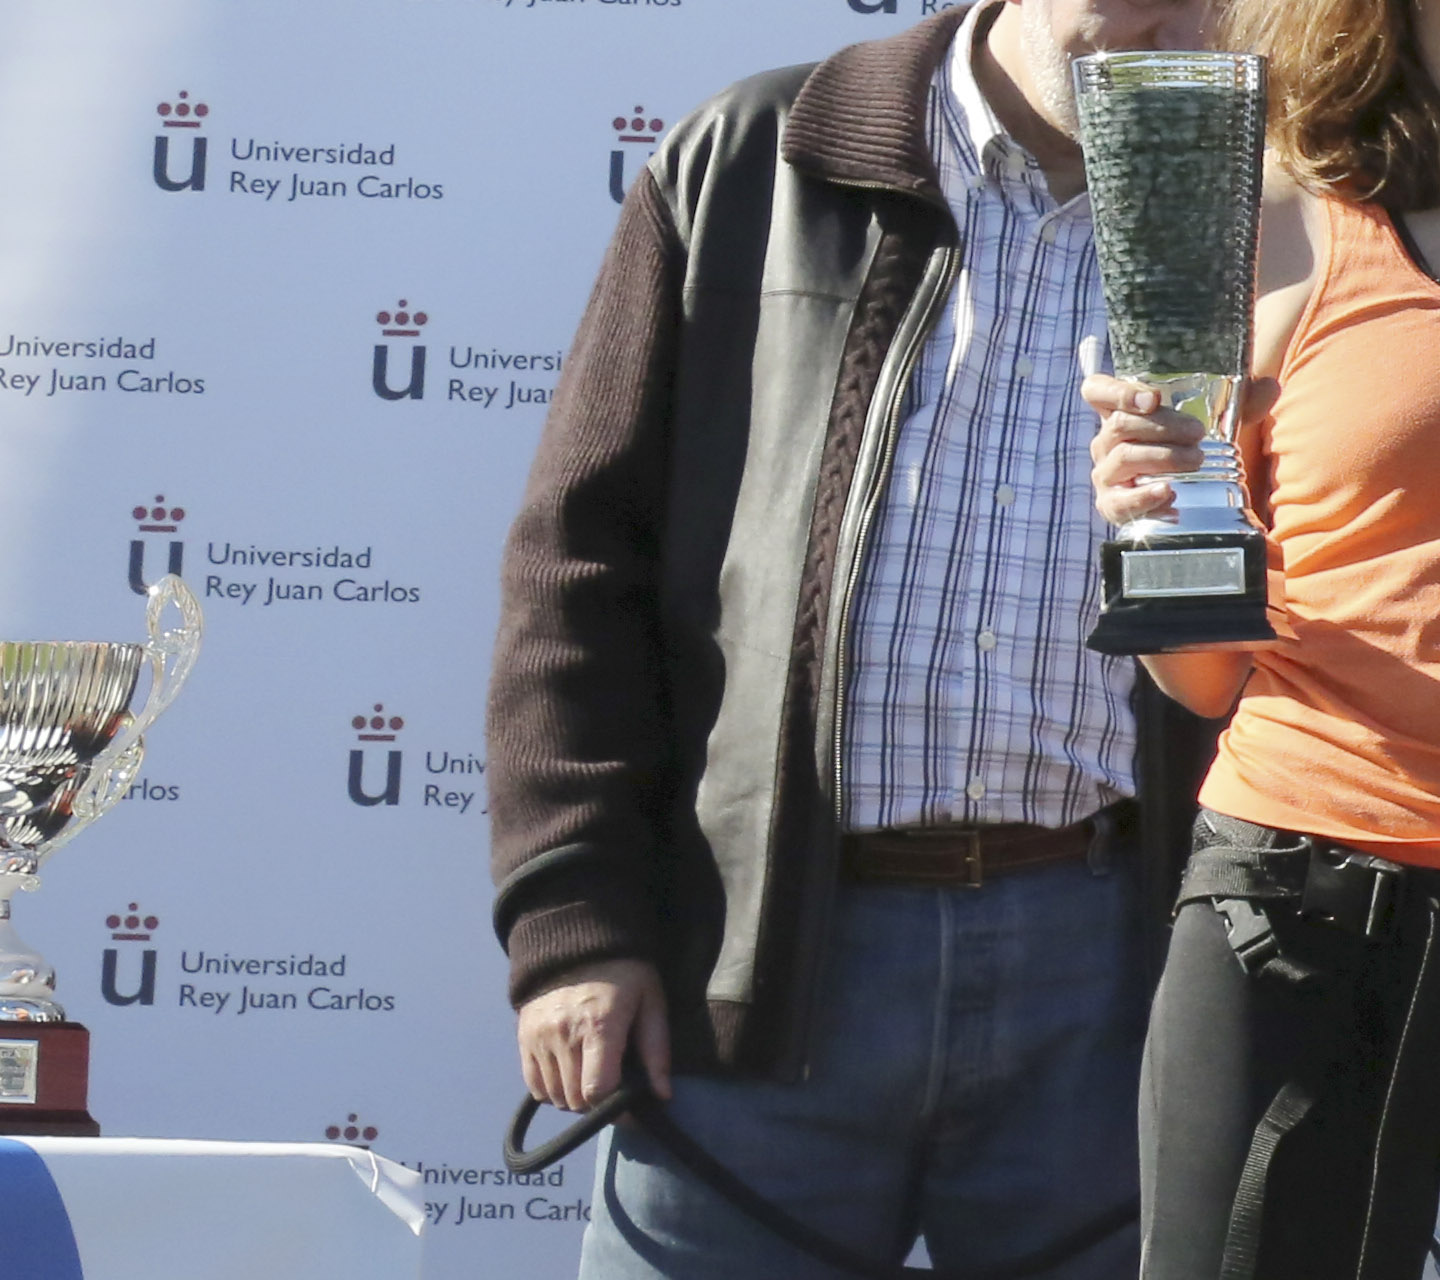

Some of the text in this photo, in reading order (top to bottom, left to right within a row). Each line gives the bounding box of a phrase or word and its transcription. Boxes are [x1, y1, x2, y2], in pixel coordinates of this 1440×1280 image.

[231, 137, 395, 166] Universidad
[229, 170, 444, 202] Rey Juan Carlos
[0, 334, 156, 360] Universidad
[450, 346, 562, 371] Universi
[46, 367, 107, 397] Juan
[116, 369, 205, 395] Carlos
[448, 379, 498, 408] Rey
[207, 542, 372, 569] Universidad
[205, 575, 420, 607] Rey Juan Carlos
[424, 784, 474, 814] Rey
[181, 951, 346, 977] Universidad
[178, 983, 395, 1016] Rey Juan Carlos
[402, 1162, 564, 1187] niversidad
[455, 1196, 514, 1225] Juan
